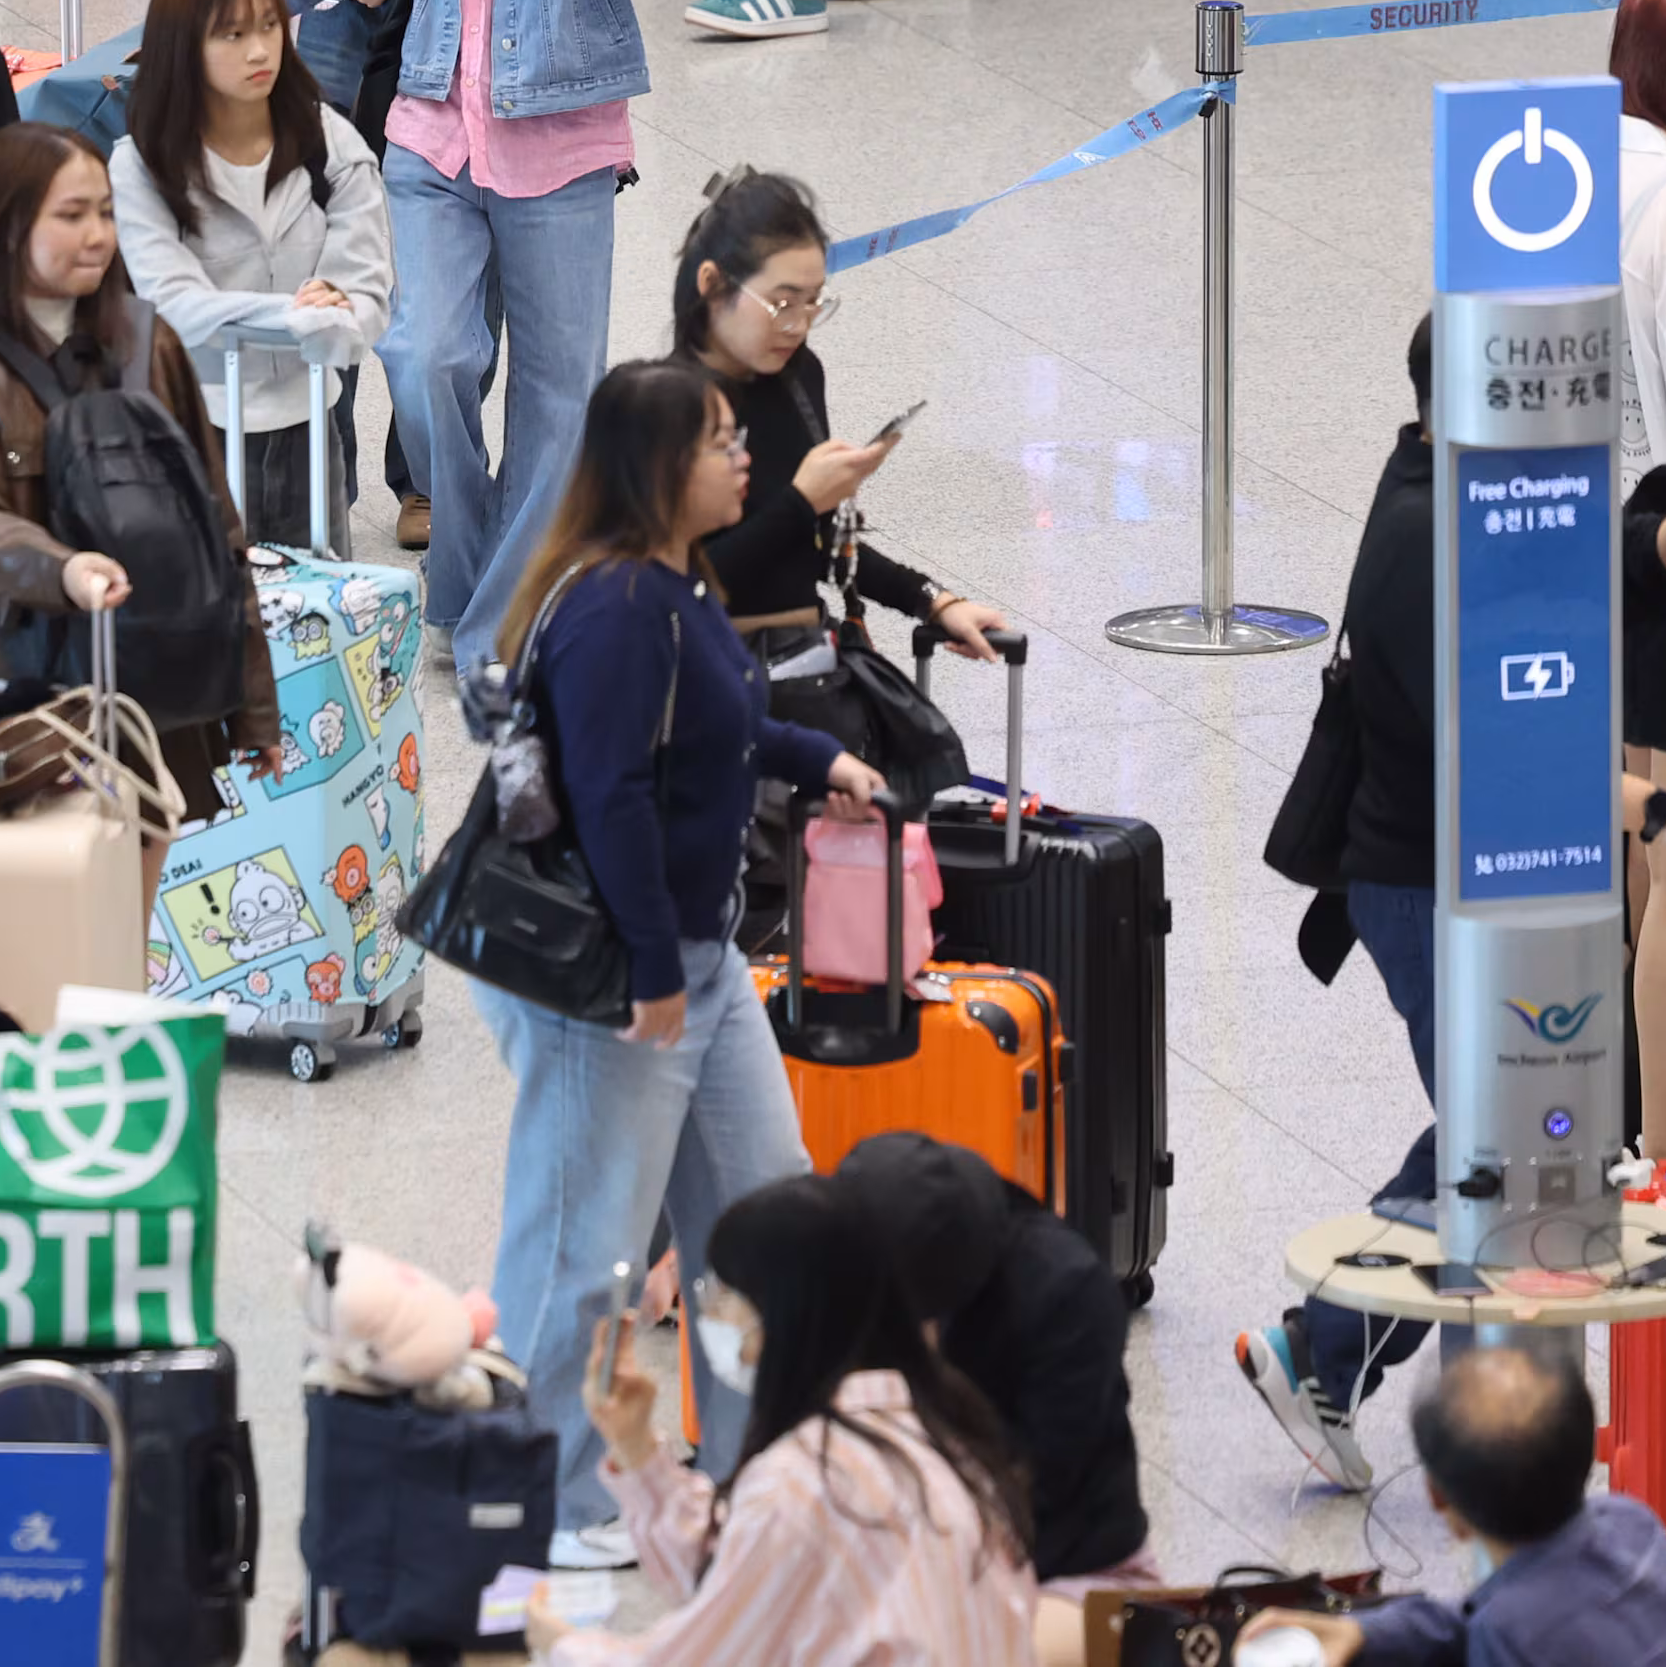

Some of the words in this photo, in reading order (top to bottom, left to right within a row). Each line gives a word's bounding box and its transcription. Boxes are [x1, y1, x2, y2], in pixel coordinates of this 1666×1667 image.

[1485, 329, 1611, 366] CHARGE
[1468, 480, 1507, 502] Free
[1509, 473, 1590, 500] Charging
[1495, 844, 1602, 872] 032)741-7514
